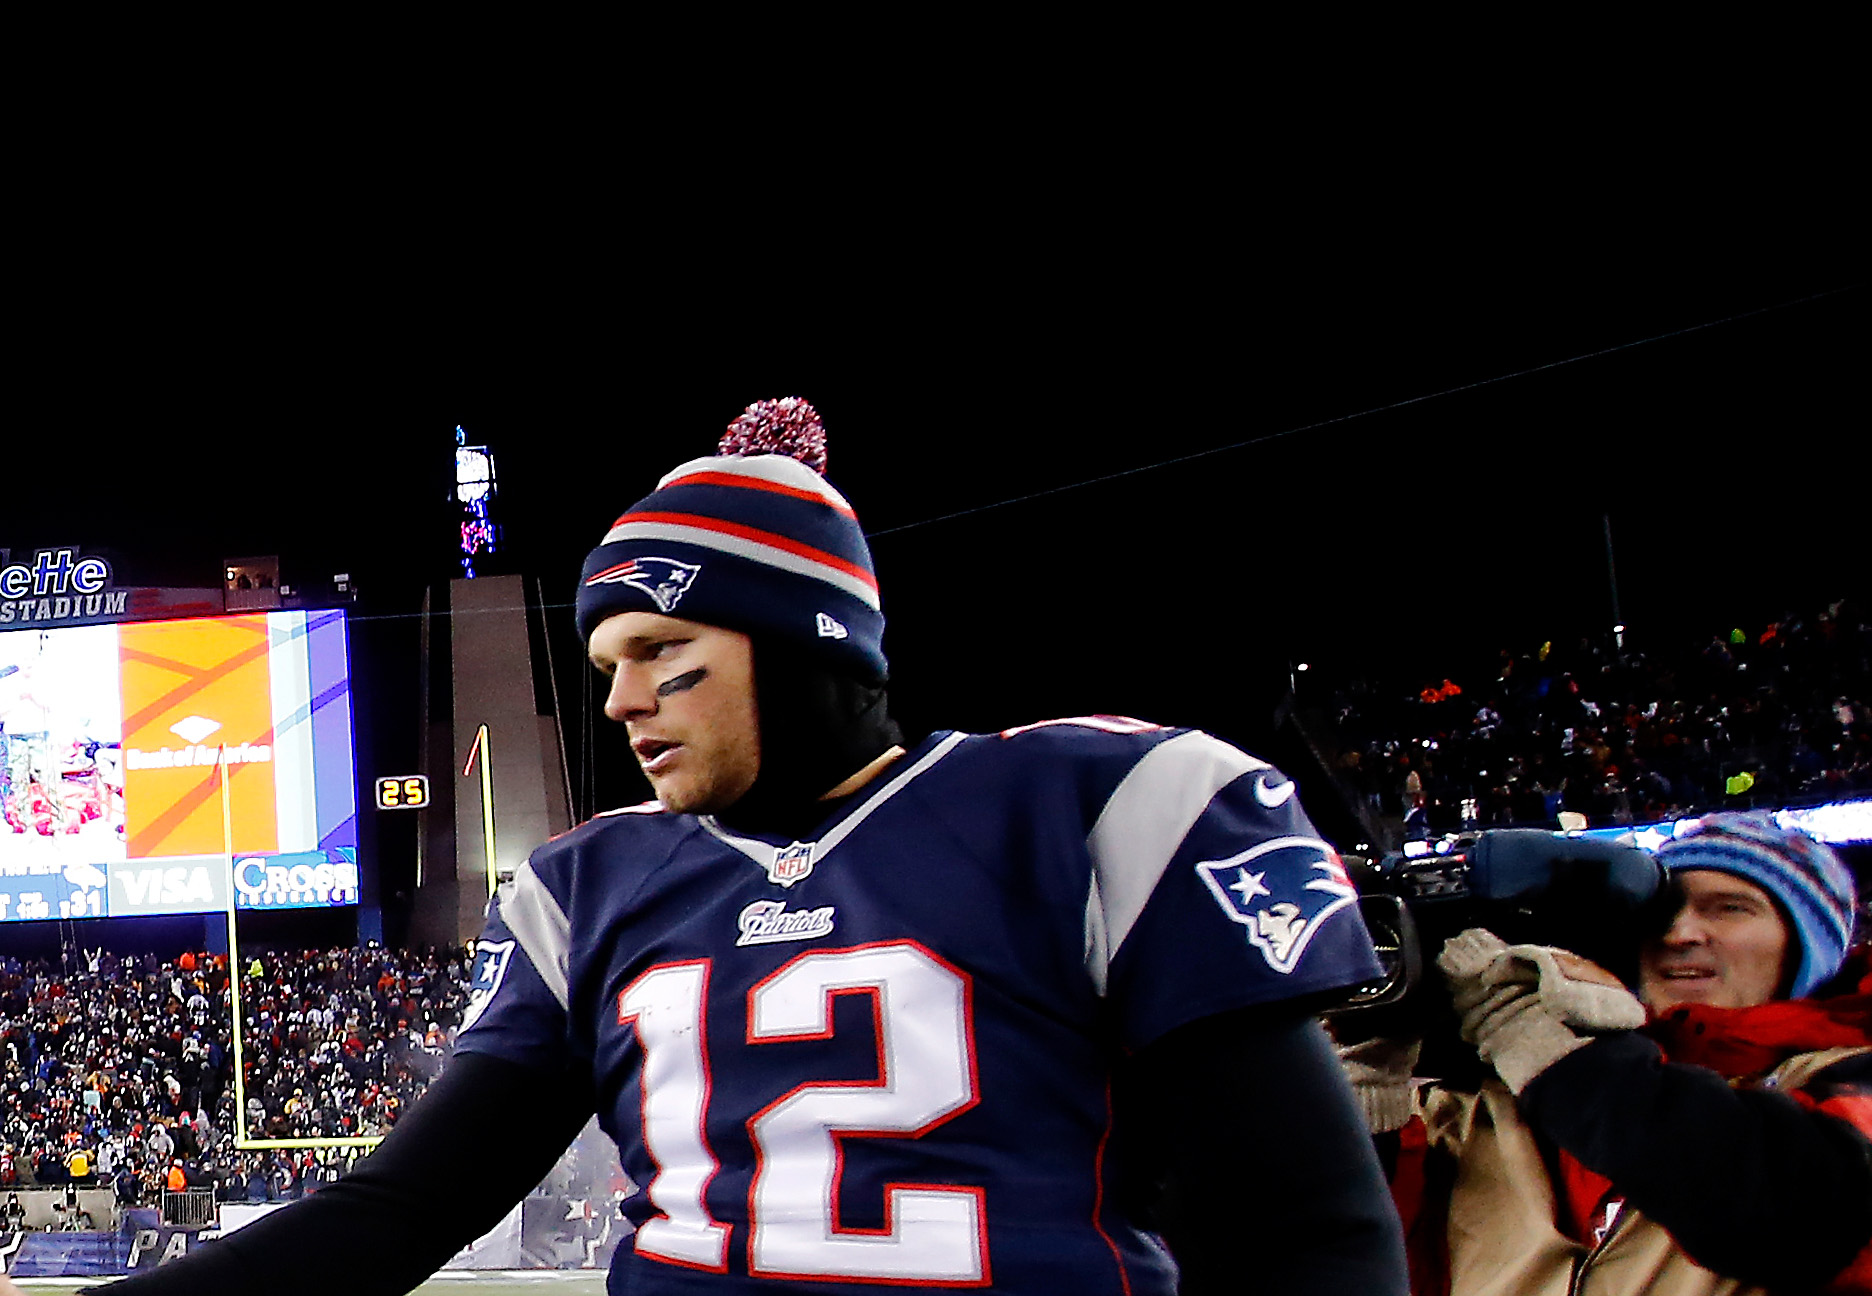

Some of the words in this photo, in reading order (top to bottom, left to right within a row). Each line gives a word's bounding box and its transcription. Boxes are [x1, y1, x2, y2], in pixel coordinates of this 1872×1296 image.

[0, 592, 127, 623] STADIUM
[383, 778, 423, 807] 25
[777, 858, 807, 876] NFL
[114, 866, 214, 906] VISA
[735, 901, 836, 946] Patriots
[617, 938, 993, 1288] 12
